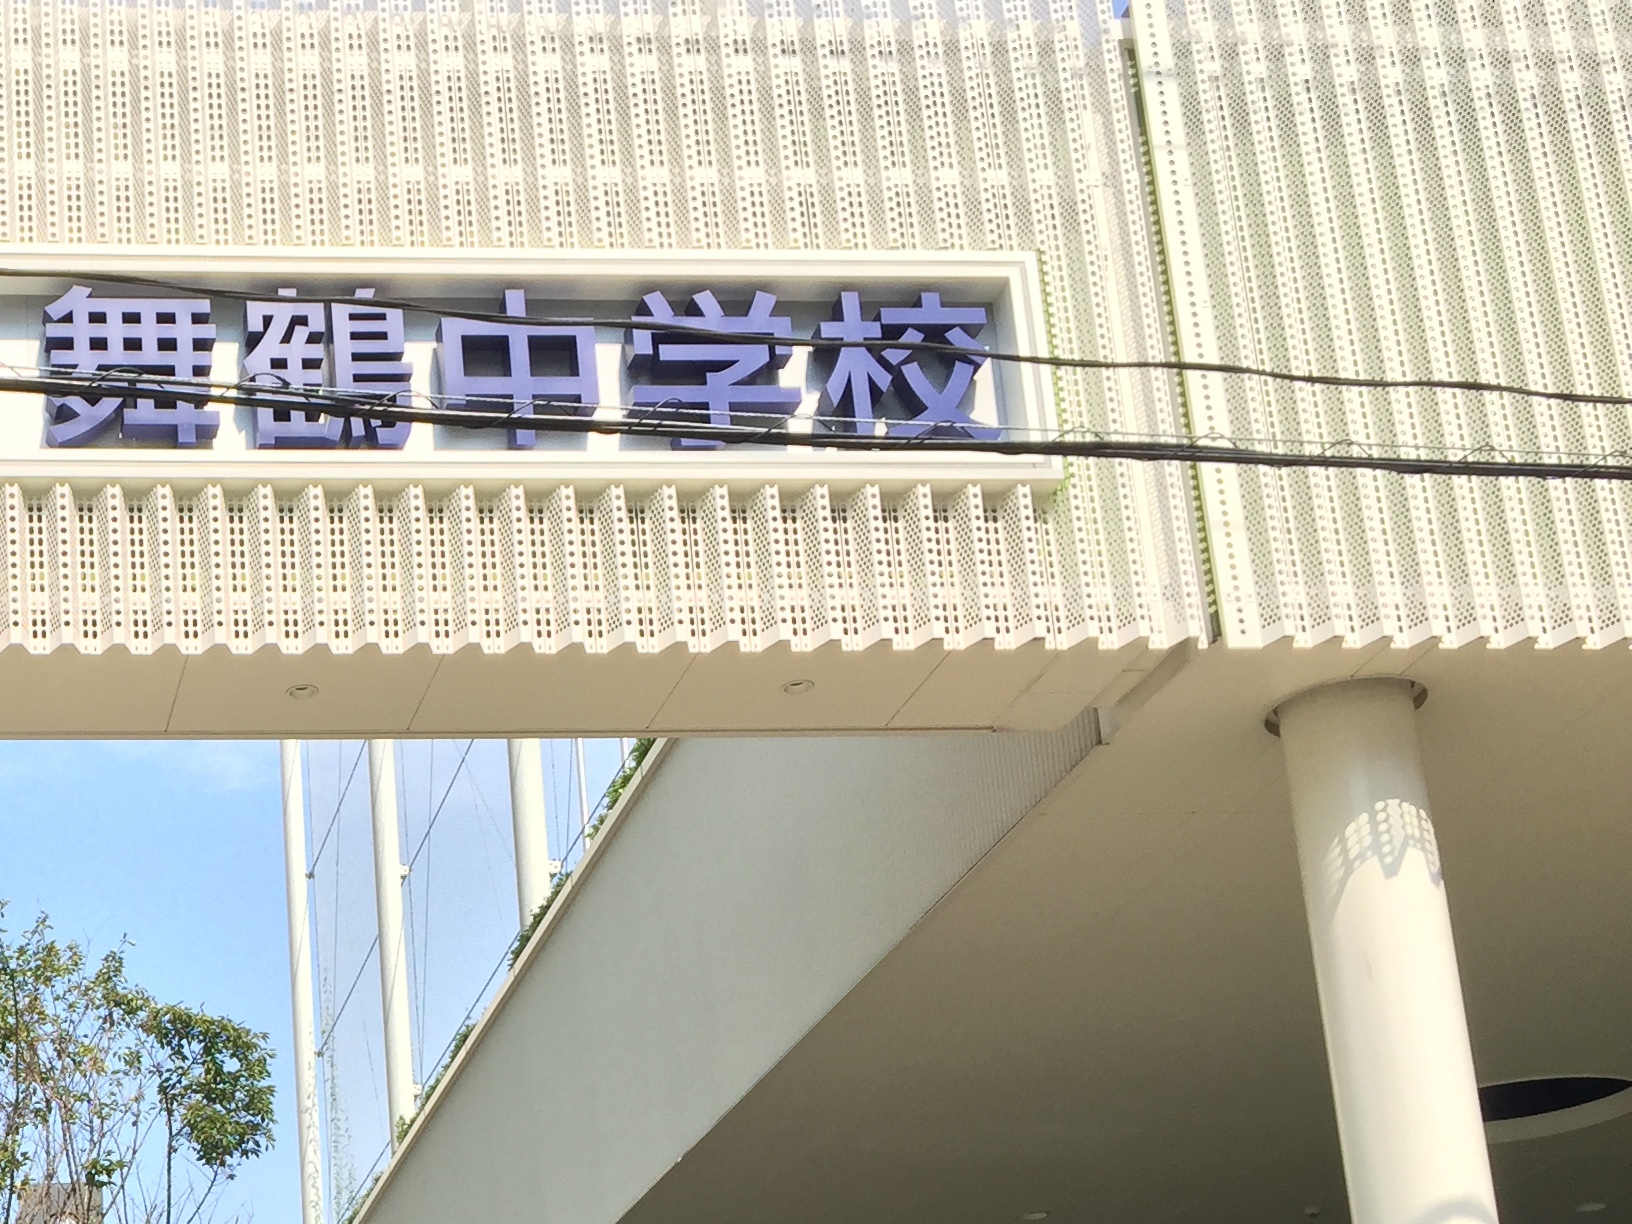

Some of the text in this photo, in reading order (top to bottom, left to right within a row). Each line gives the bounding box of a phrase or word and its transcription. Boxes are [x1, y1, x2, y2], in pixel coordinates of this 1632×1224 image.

[42, 284, 1004, 450] 舞鶴中学校
